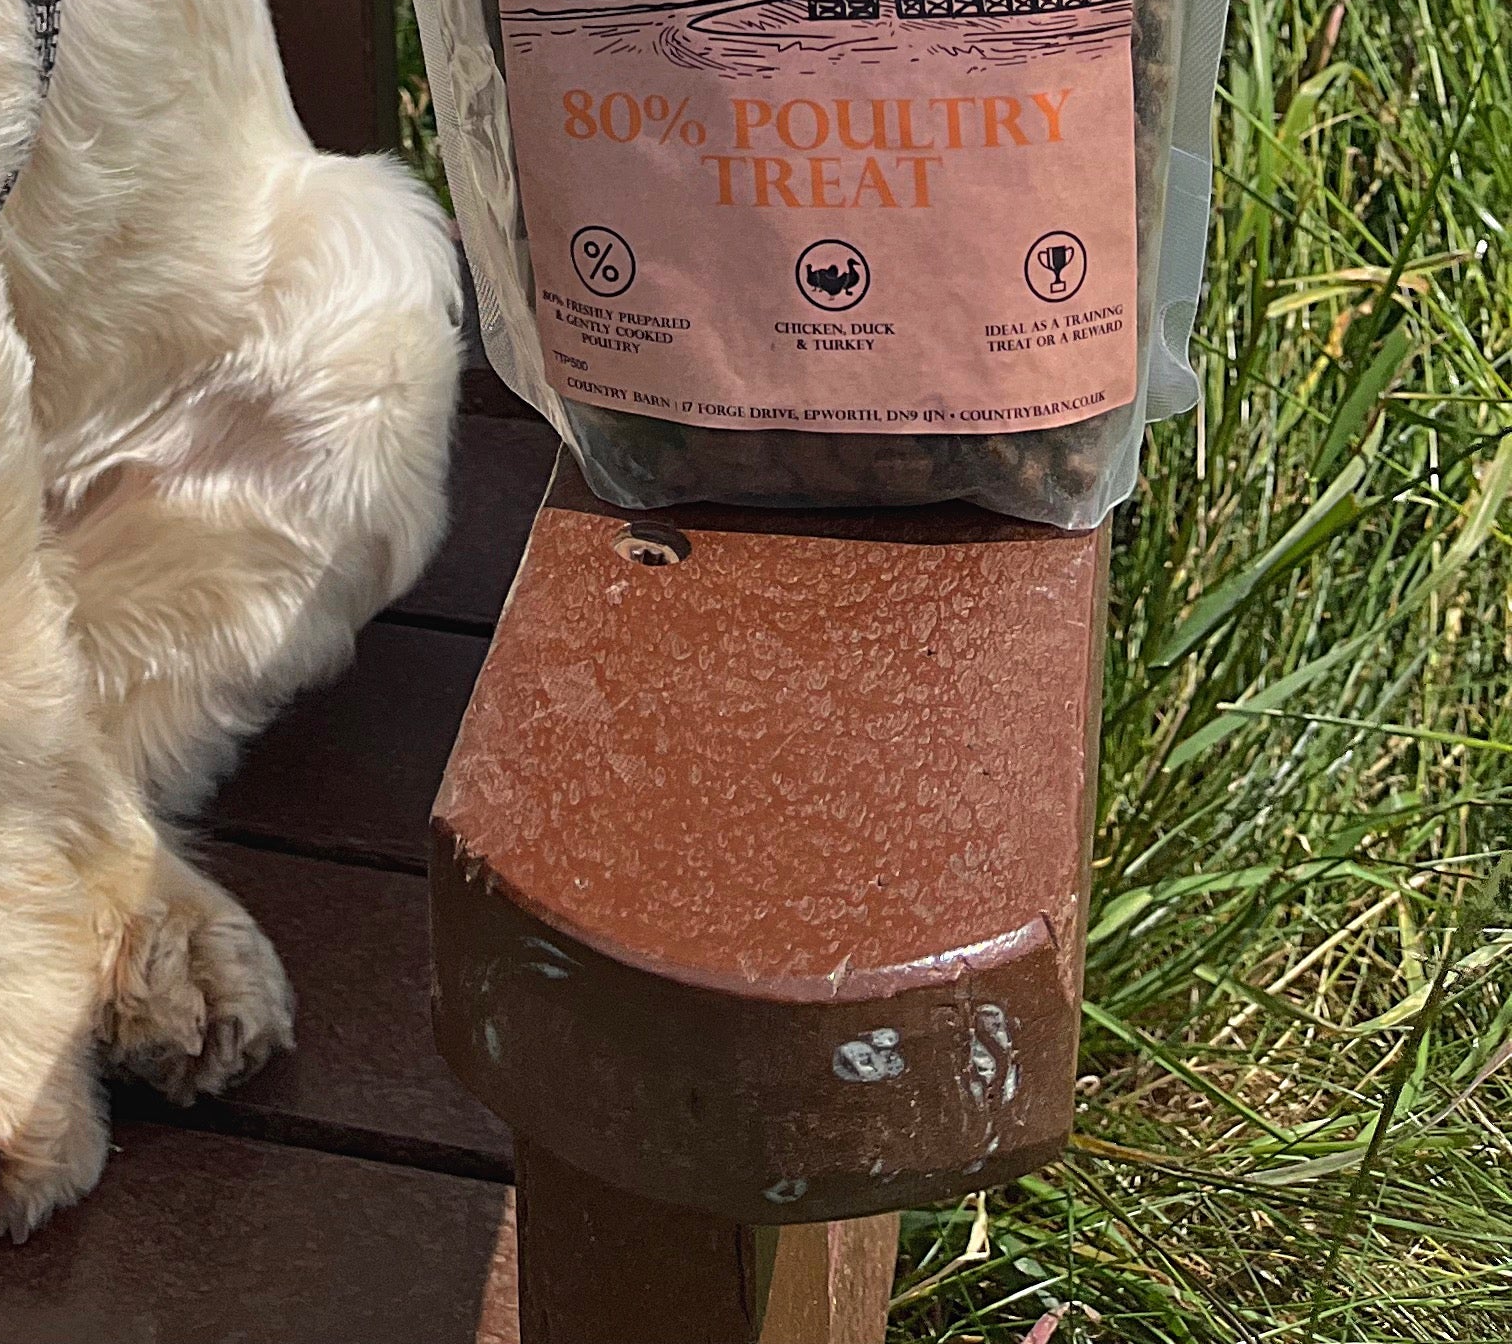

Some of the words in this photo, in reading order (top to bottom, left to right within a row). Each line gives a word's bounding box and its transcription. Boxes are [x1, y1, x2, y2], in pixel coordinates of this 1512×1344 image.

[562, 88, 707, 147] 80%
[729, 88, 1072, 152] POULTRY
[701, 154, 944, 209] TREAT
[555, 309, 564, 322] &
[566, 314, 611, 334] GENTLY
[615, 326, 674, 344] COOKED
[566, 297, 614, 321] FRESHLY
[618, 311, 691, 330] PREPARED
[774, 322, 846, 336] CHICKEN,
[851, 323, 895, 335] DUCK
[985, 322, 1026, 337] IDEAL
[1031, 320, 1047, 332] AS
[1051, 318, 1059, 329] A
[1063, 304, 1123, 328] TRAINING
[581, 332, 641, 354] POULTRY
[796, 339, 807, 350] &
[813, 339, 874, 350] TURKEY
[987, 337, 1032, 352] TREAT
[1036, 334, 1056, 347] OR
[1060, 333, 1068, 344] A
[1072, 319, 1123, 341] REWARD
[567, 376, 628, 400] COUNTRY
[633, 391, 671, 408] BARN
[698, 403, 746, 417] FORGE
[750, 407, 799, 420] DRIVE,
[804, 408, 882, 422] EPWORTH,
[887, 409, 918, 422] DN9
[960, 389, 1106, 421] COUNTRYBARN.CO.UK
